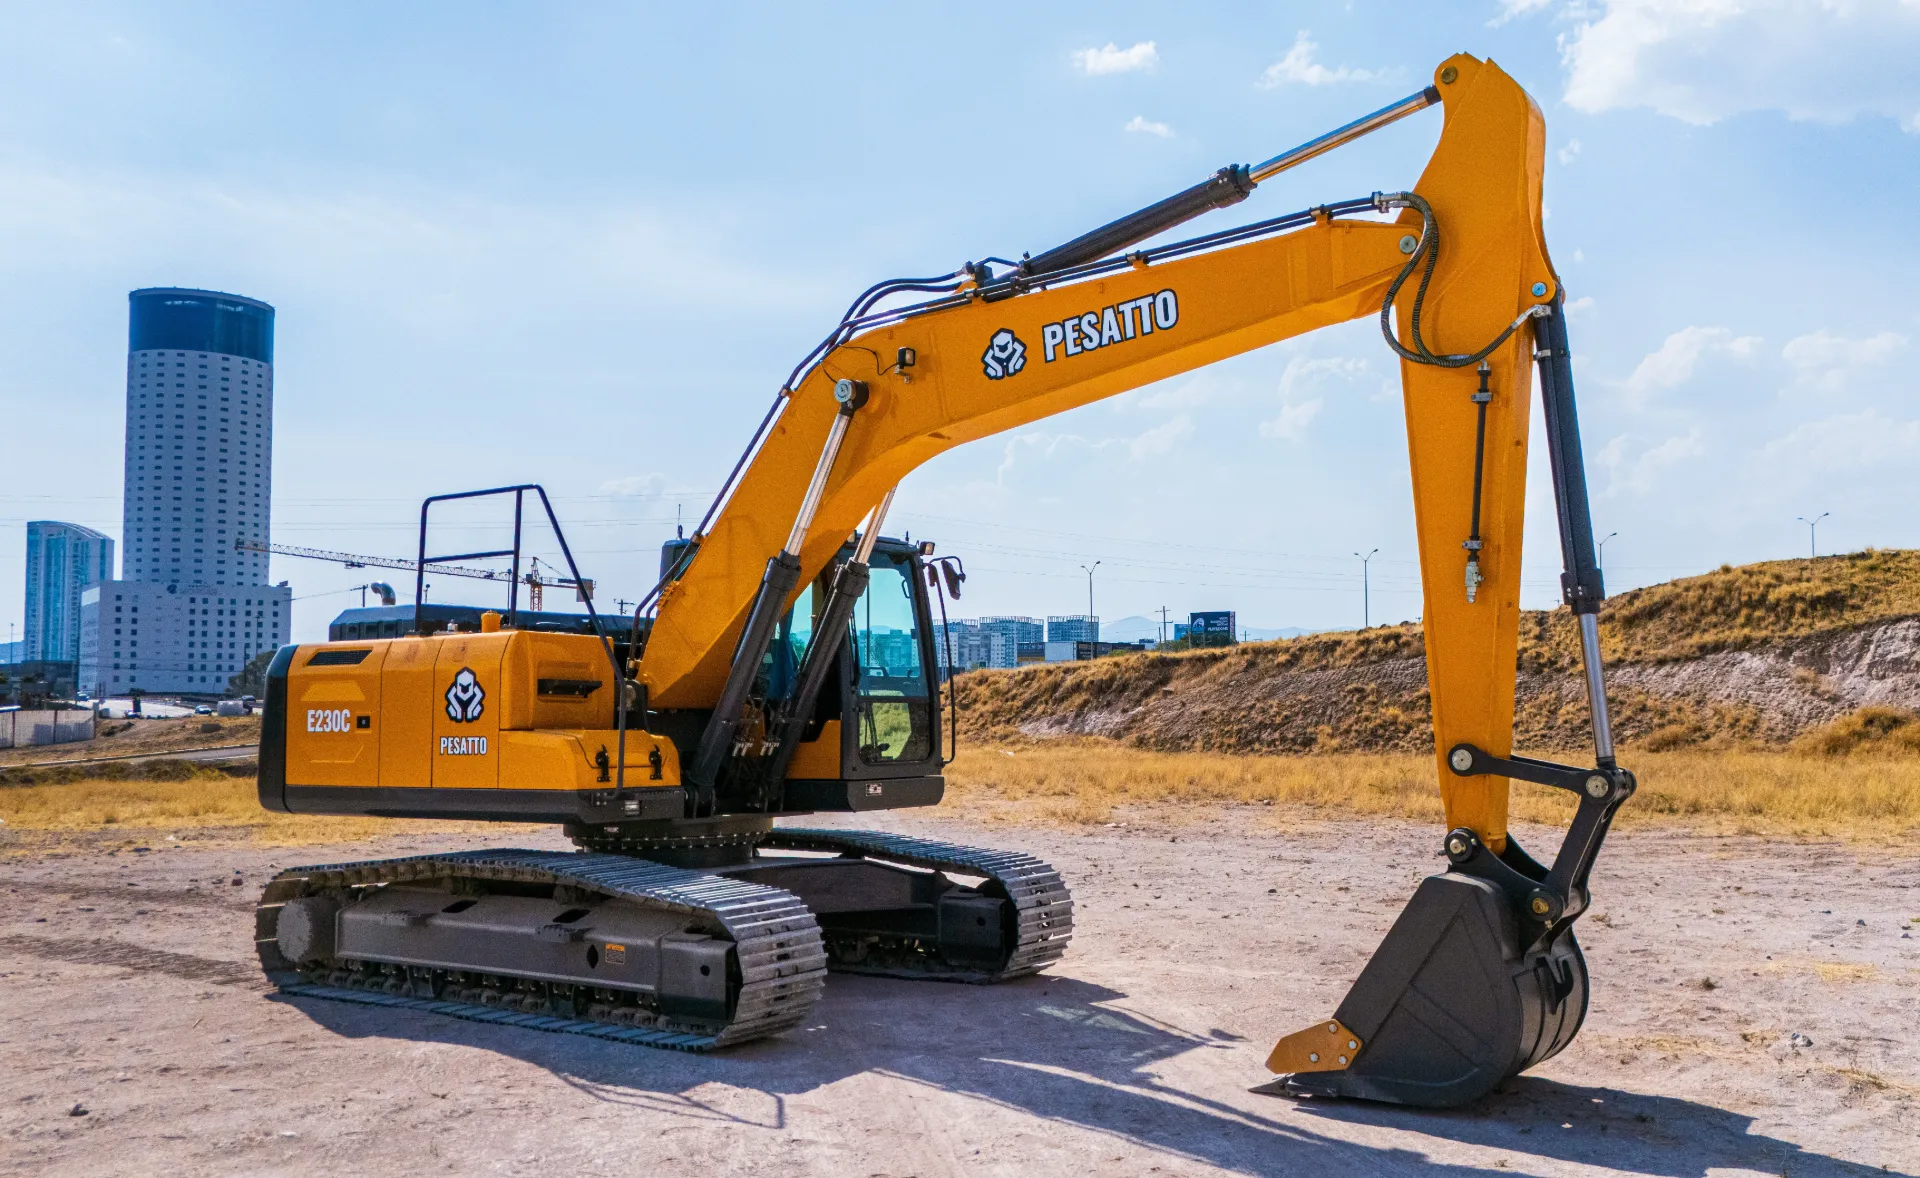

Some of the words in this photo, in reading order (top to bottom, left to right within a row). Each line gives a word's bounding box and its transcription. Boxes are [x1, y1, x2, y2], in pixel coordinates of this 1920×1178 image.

[1042, 288, 1179, 363] PESATTO
[307, 709, 350, 732] E230C
[440, 736, 487, 755] PESATTO
